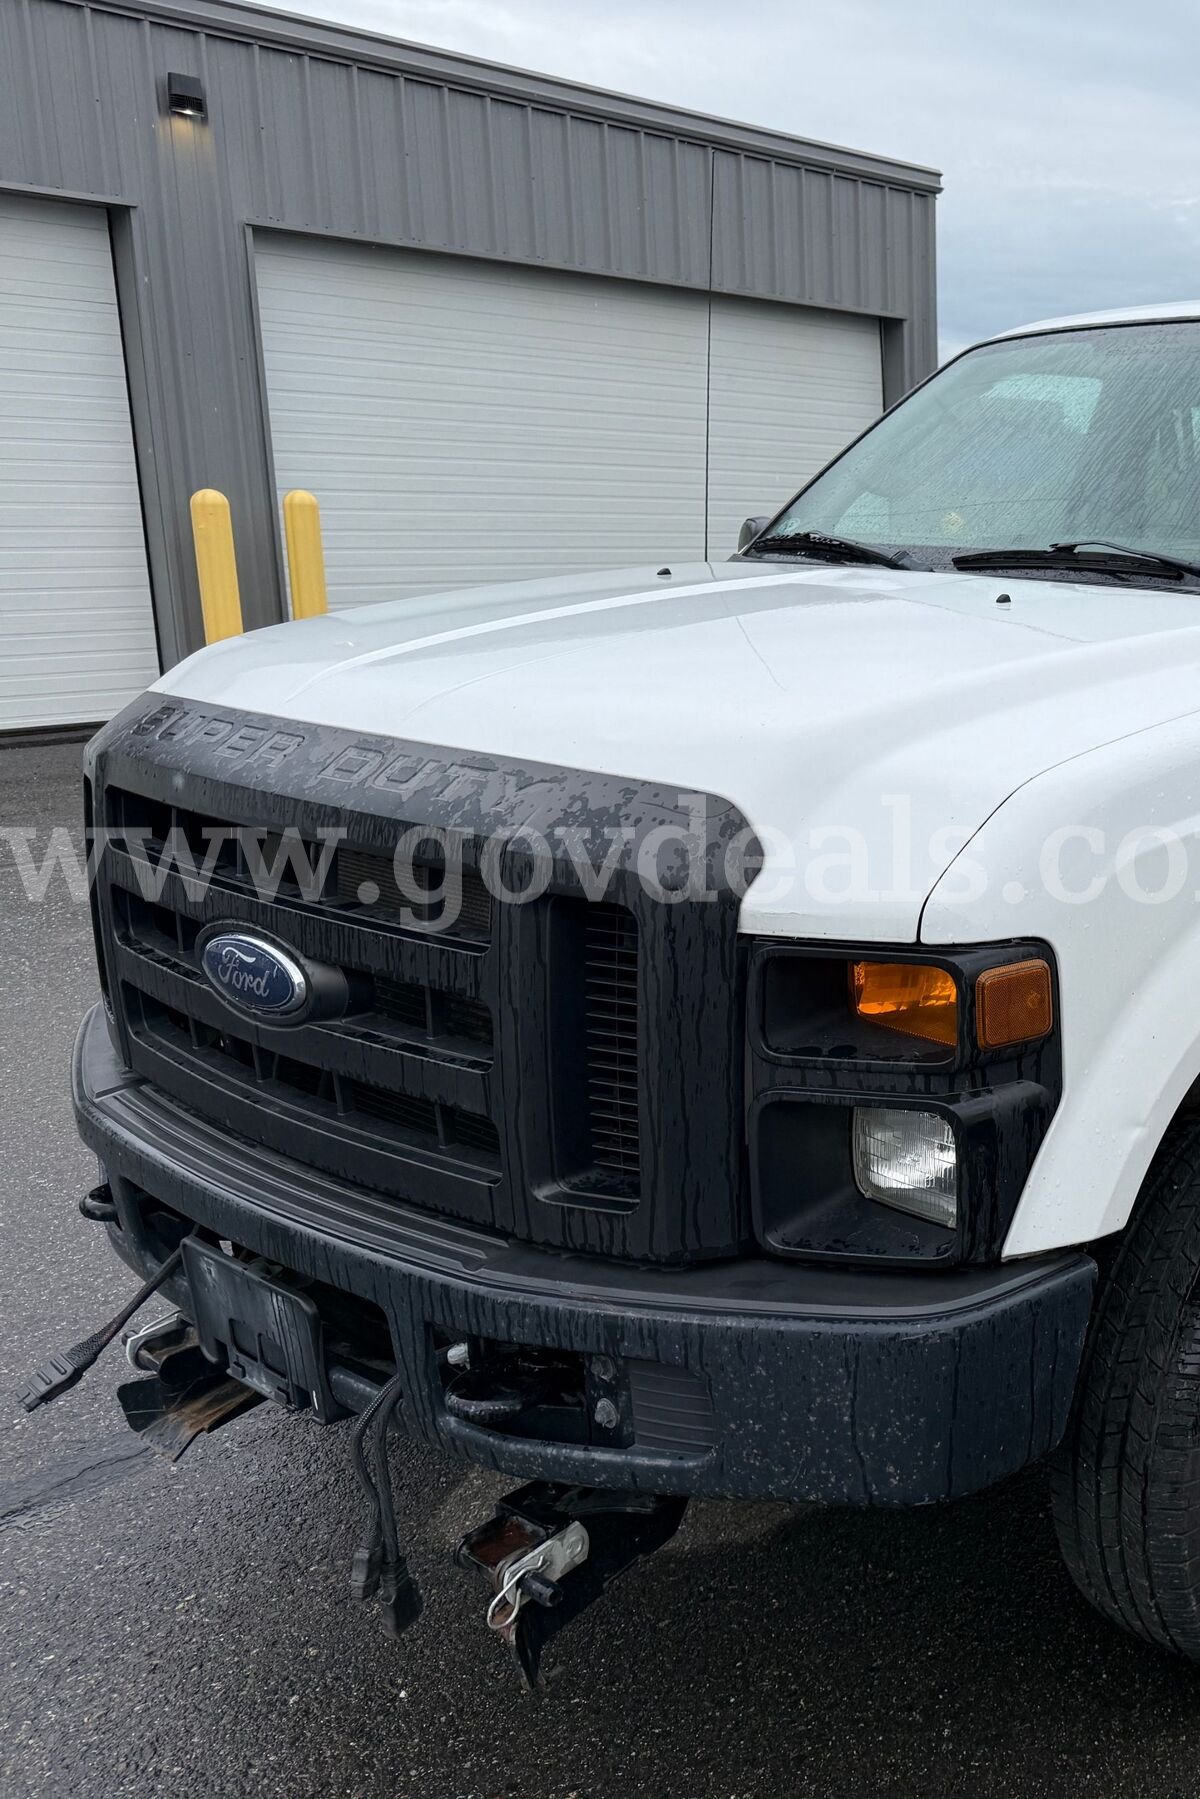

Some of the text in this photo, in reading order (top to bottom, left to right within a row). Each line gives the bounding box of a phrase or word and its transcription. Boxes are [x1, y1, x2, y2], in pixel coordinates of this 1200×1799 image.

[130, 705, 564, 813] SUPER DUTY
[218, 946, 272, 998] Ford
